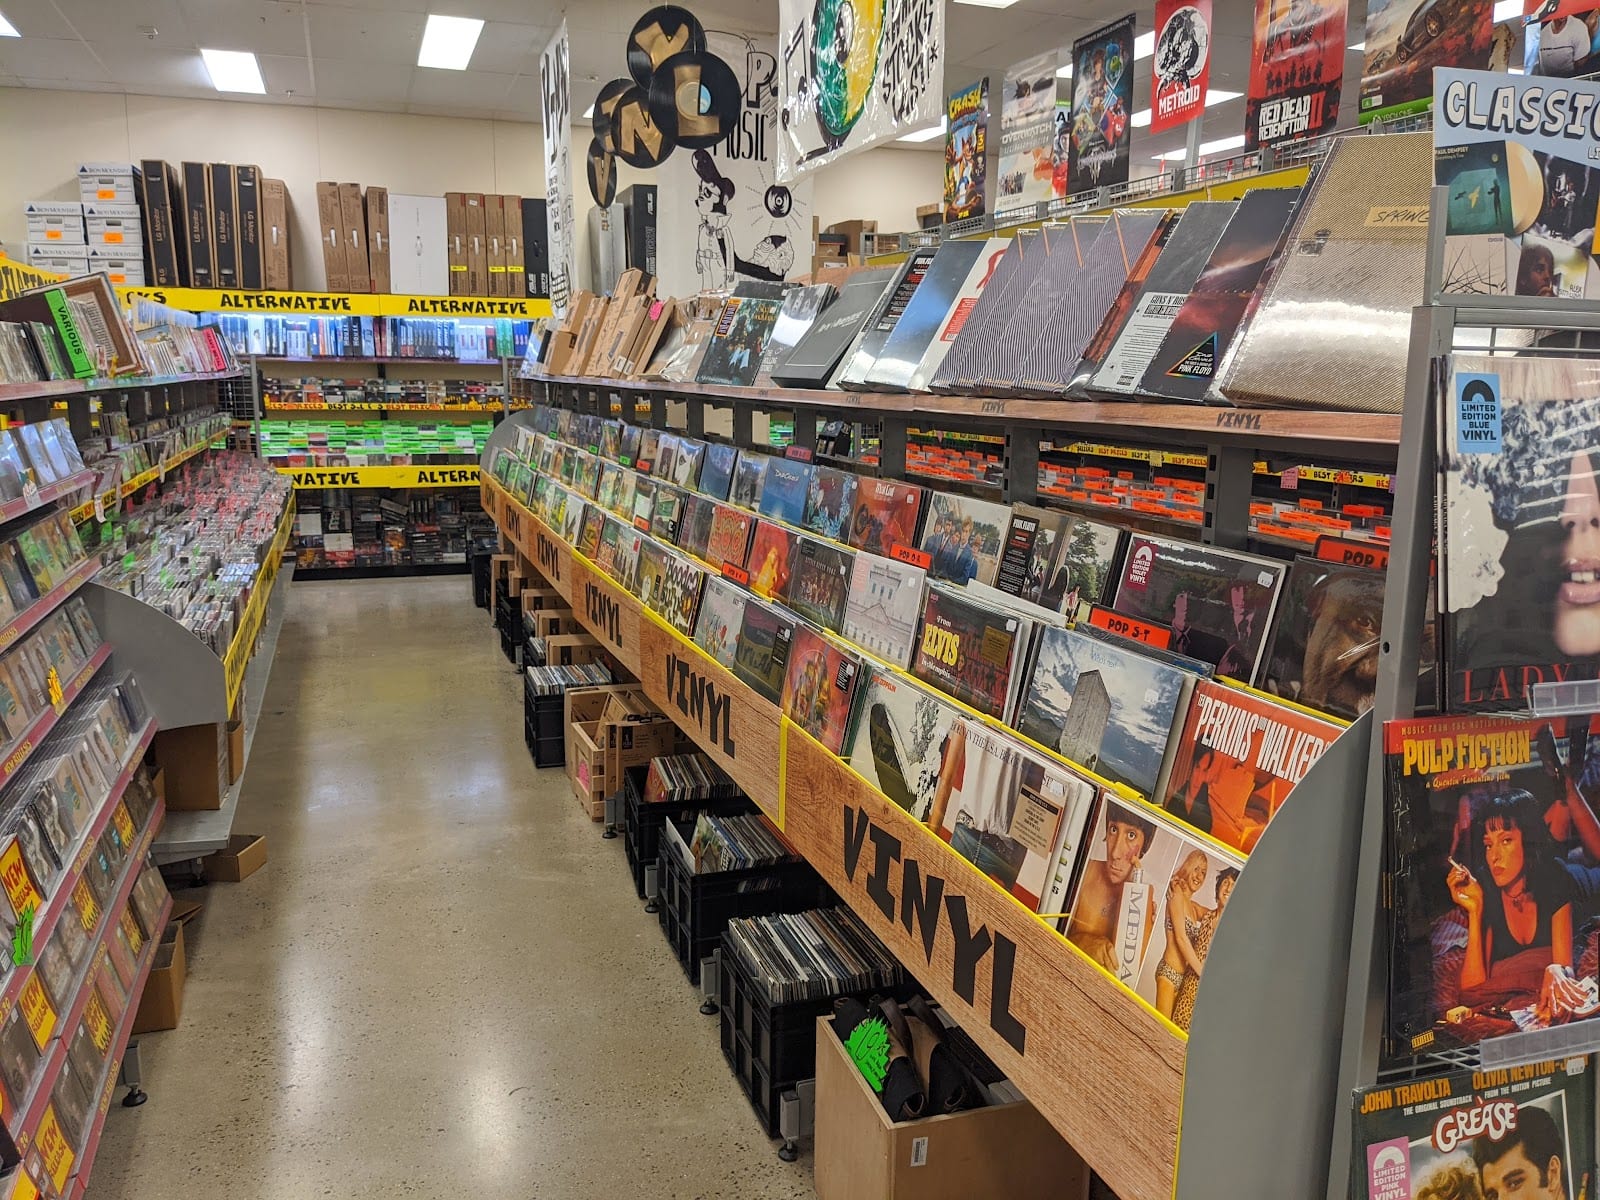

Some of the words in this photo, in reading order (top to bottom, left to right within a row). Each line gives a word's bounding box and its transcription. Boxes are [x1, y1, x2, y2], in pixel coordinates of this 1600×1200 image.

[949, 90, 981, 119] CRASH
[1158, 84, 1200, 115] METROID
[1259, 101, 1280, 127] RED
[1281, 95, 1311, 122] DEAD
[713, 110, 769, 162] USIC
[1001, 121, 1053, 145] OVERWATCH
[1258, 115, 1310, 142] REDEMPTION
[220, 293, 351, 311] ALTERNATIVE
[408, 299, 528, 315] ALTERNATIVE
[58, 304, 83, 357] VARIOUS
[1192, 366, 1212, 376] FLOYD
[1461, 404, 1497, 413] LIMITED
[1461, 412, 1497, 421] EDITION
[1216, 412, 1262, 430] VINYL
[1469, 421, 1490, 429] BLUE
[1462, 430, 1497, 442] VINYL
[1313, 471, 1331, 481] BEST
[536, 533, 561, 582] VINYL
[1132, 563, 1150, 572] EDITION
[1133, 559, 1151, 567] LIMITED
[1343, 549, 1374, 566] POP
[1130, 574, 1146, 584] VINYL
[1132, 569, 1147, 577] VIOLET
[585, 581, 623, 649] VINYL
[936, 615, 952, 628] From
[1107, 618, 1129, 633] POP
[1131, 626, 1151, 641] S-T
[921, 622, 960, 667] ELVIS
[1463, 662, 1571, 704] LADY
[665, 653, 736, 760] VINYL
[1194, 696, 1259, 763] PERKINS
[1401, 725, 1425, 736] MUSIC
[1428, 724, 1448, 733] FROM
[1452, 722, 1466, 730] THE
[1469, 720, 1497, 729] MOTION
[1403, 737, 1454, 777] PULP
[1456, 729, 1531, 771] FICTION
[1433, 775, 1459, 789] Quentin
[1462, 773, 1495, 785] Tarantino
[1495, 773, 1511, 783] film
[3, 859, 24, 895] NEW
[843, 804, 1026, 1057] VINYL
[22, 976, 41, 1016] NEW
[1360, 1089, 1393, 1115] JOHN
[1394, 1077, 1452, 1107] TRAVOLTA
[1472, 1066, 1508, 1092] OLIVIA
[1403, 1106, 1415, 1117] THE
[1414, 1102, 1440, 1115] ORIGINAL
[1439, 1094, 1473, 1111] SOUNDTRACK
[1484, 1087, 1500, 1100] FROM
[1500, 1084, 1511, 1096] THE
[1511, 1080, 1531, 1094] MOTION
[1531, 1076, 1553, 1090] PICTURE
[1434, 1101, 1518, 1153] GREASE
[38, 1127, 58, 1163] NEW
[1373, 1165, 1406, 1179] LIMITED
[1373, 1172, 1406, 1187] EDITION
[1374, 1187, 1408, 1200] VINYL
[1381, 1181, 1400, 1192] PINK
